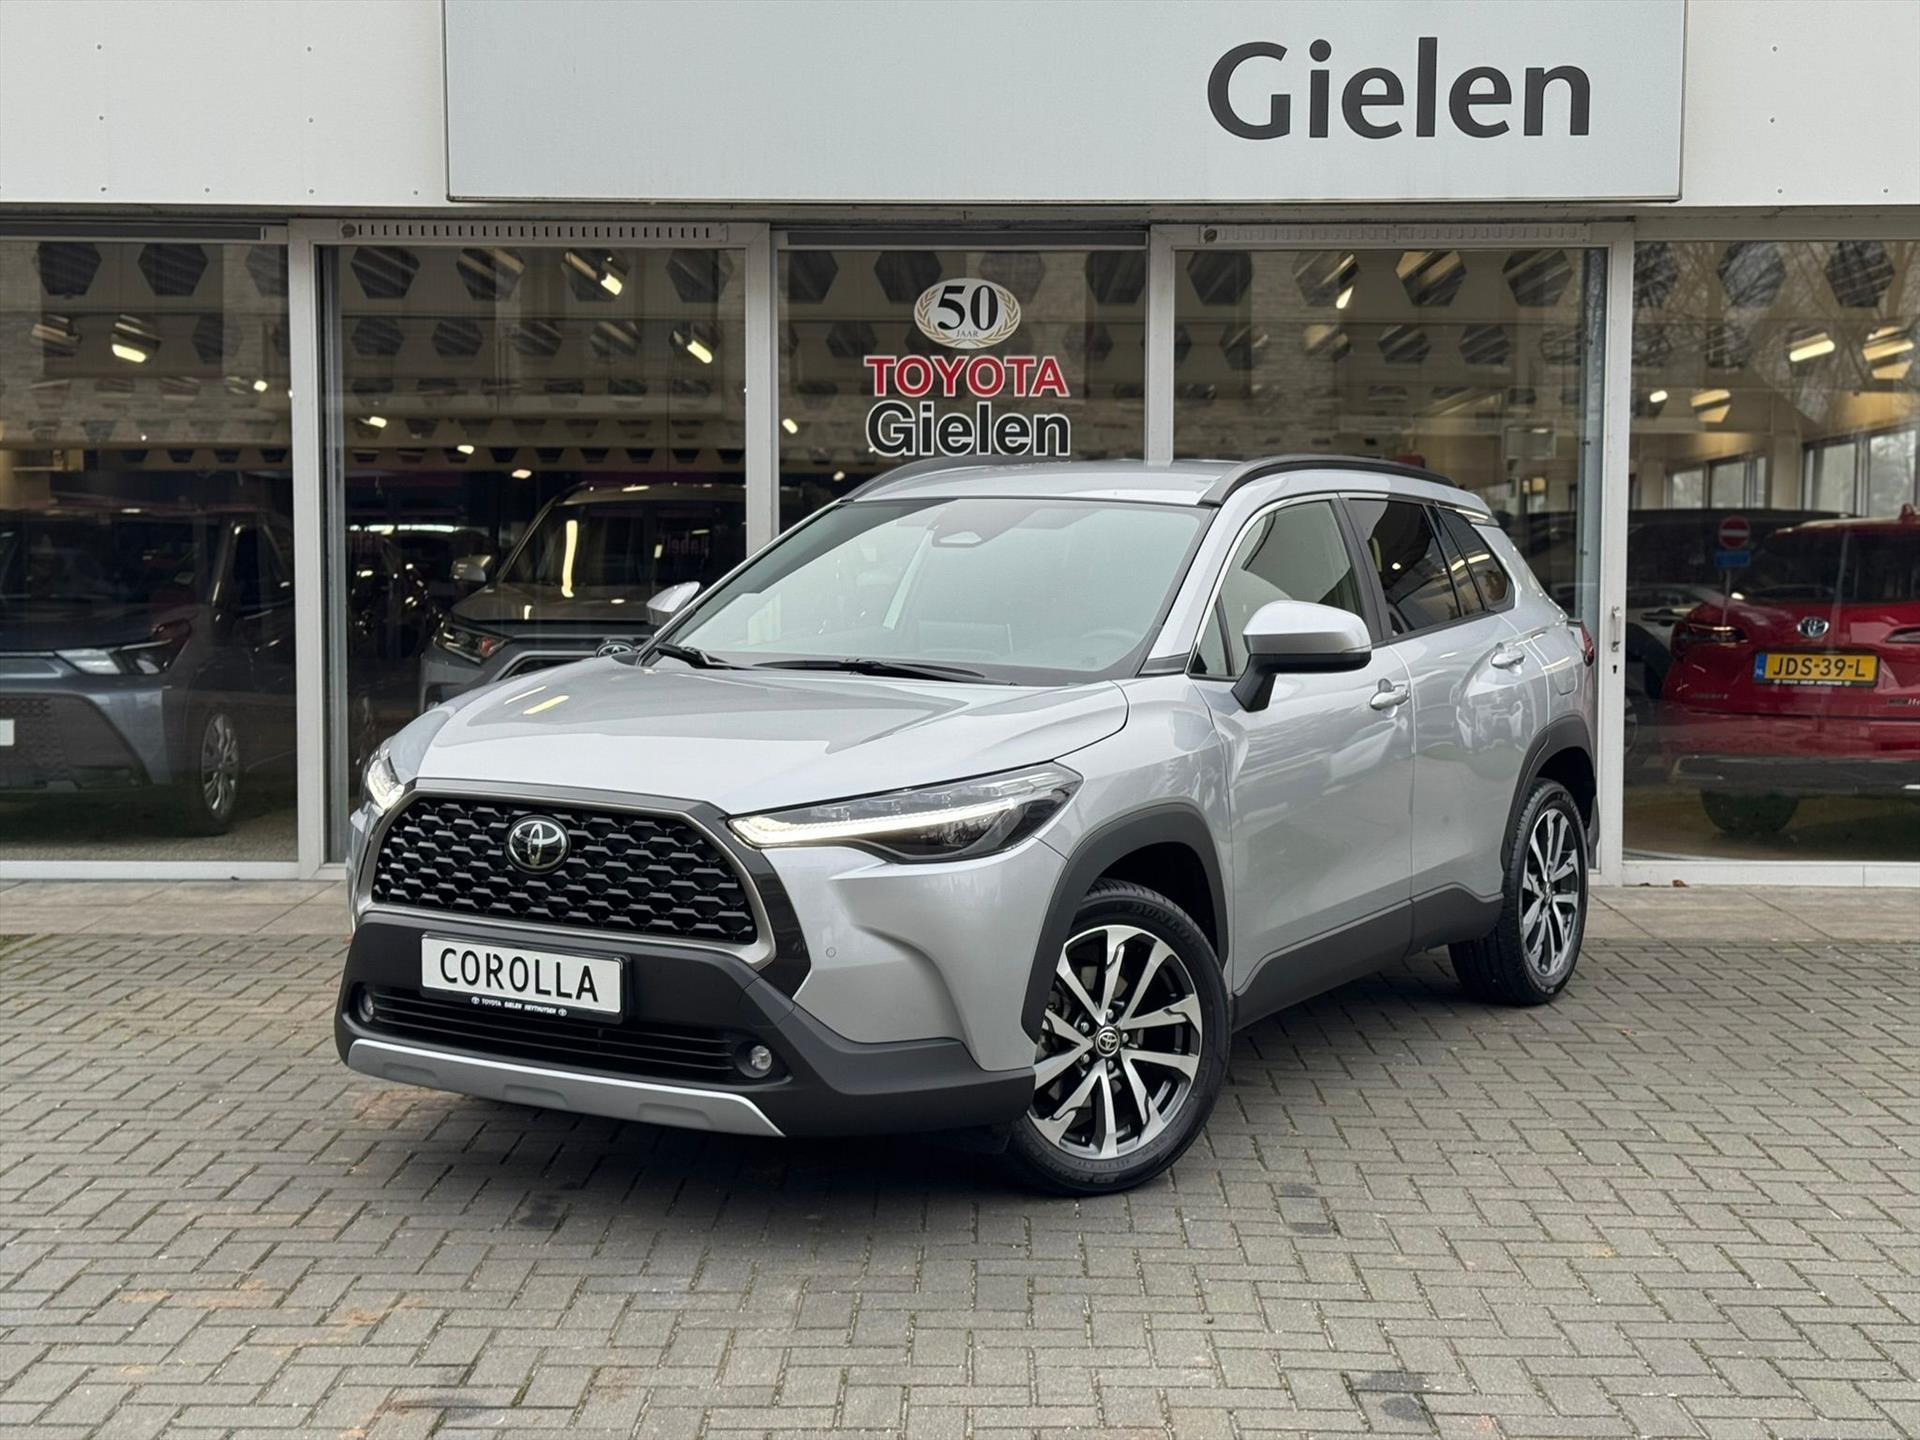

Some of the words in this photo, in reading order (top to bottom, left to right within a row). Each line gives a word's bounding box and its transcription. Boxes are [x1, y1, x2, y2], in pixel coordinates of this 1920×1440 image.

[1207, 36, 1591, 140] Gielen
[937, 284, 999, 330] 50
[955, 329, 979, 338] JAAR
[864, 355, 1070, 397] TOYOTA
[866, 400, 1071, 457] Gielen
[1773, 657, 1866, 678] JDS-39-L
[440, 948, 599, 1003] COROLLA
[481, 998, 502, 1007] TOYOTA
